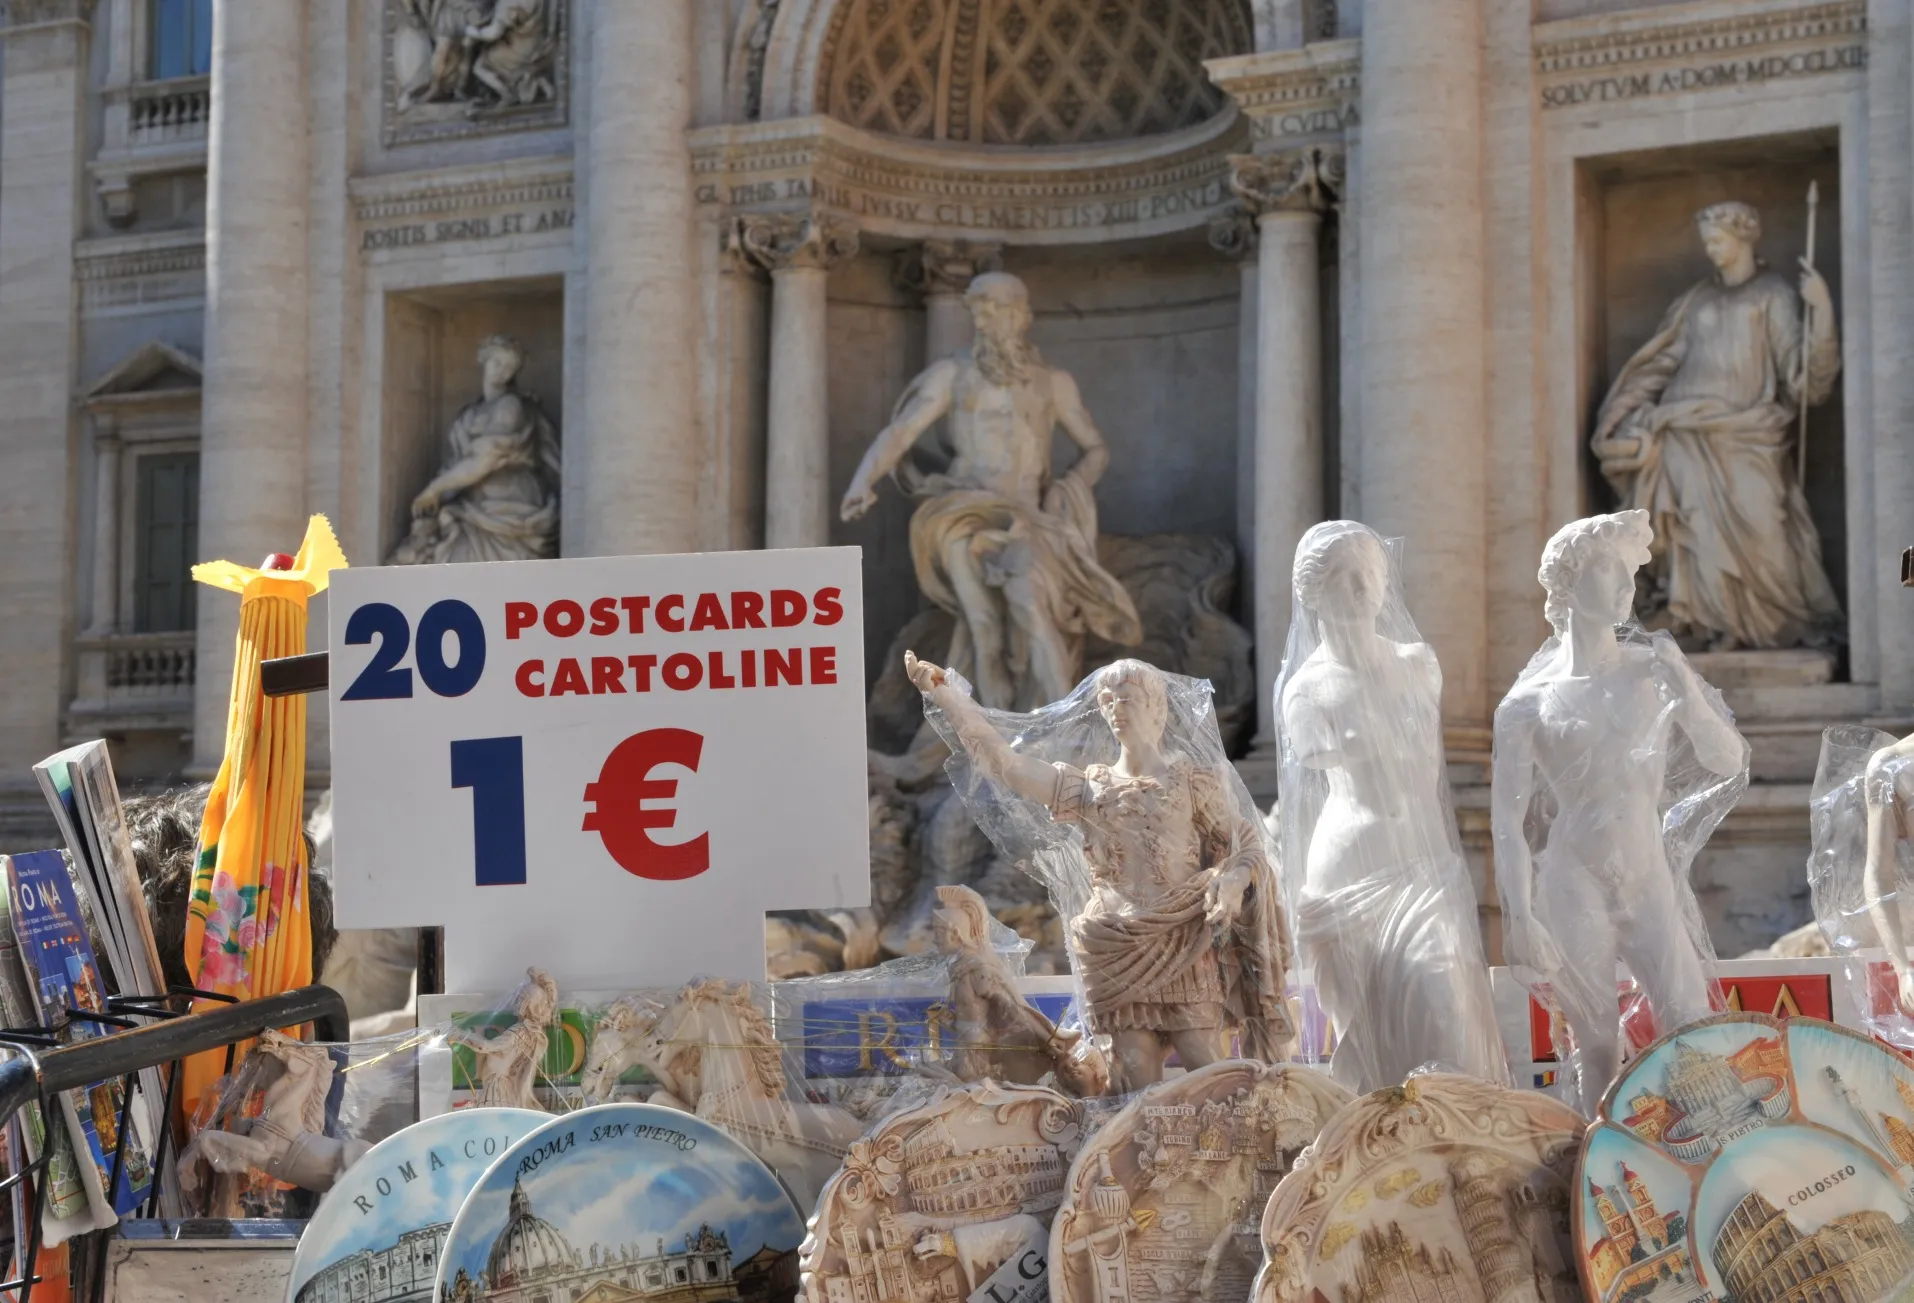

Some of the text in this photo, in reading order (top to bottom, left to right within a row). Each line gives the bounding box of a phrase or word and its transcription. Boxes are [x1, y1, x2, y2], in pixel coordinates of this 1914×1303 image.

[340, 586, 844, 702] 20 POSTCARDS
[514, 646, 838, 698] CARTOLINE
[450, 727, 710, 886] 1 €
[12, 879, 62, 913] ROMA
[519, 1123, 697, 1175] ROMA SAN PIETRO
[1728, 1118, 1764, 1143] PIETRO
[353, 1150, 445, 1216] ROMA
[1787, 1164, 1856, 1206] COLOSSEO
